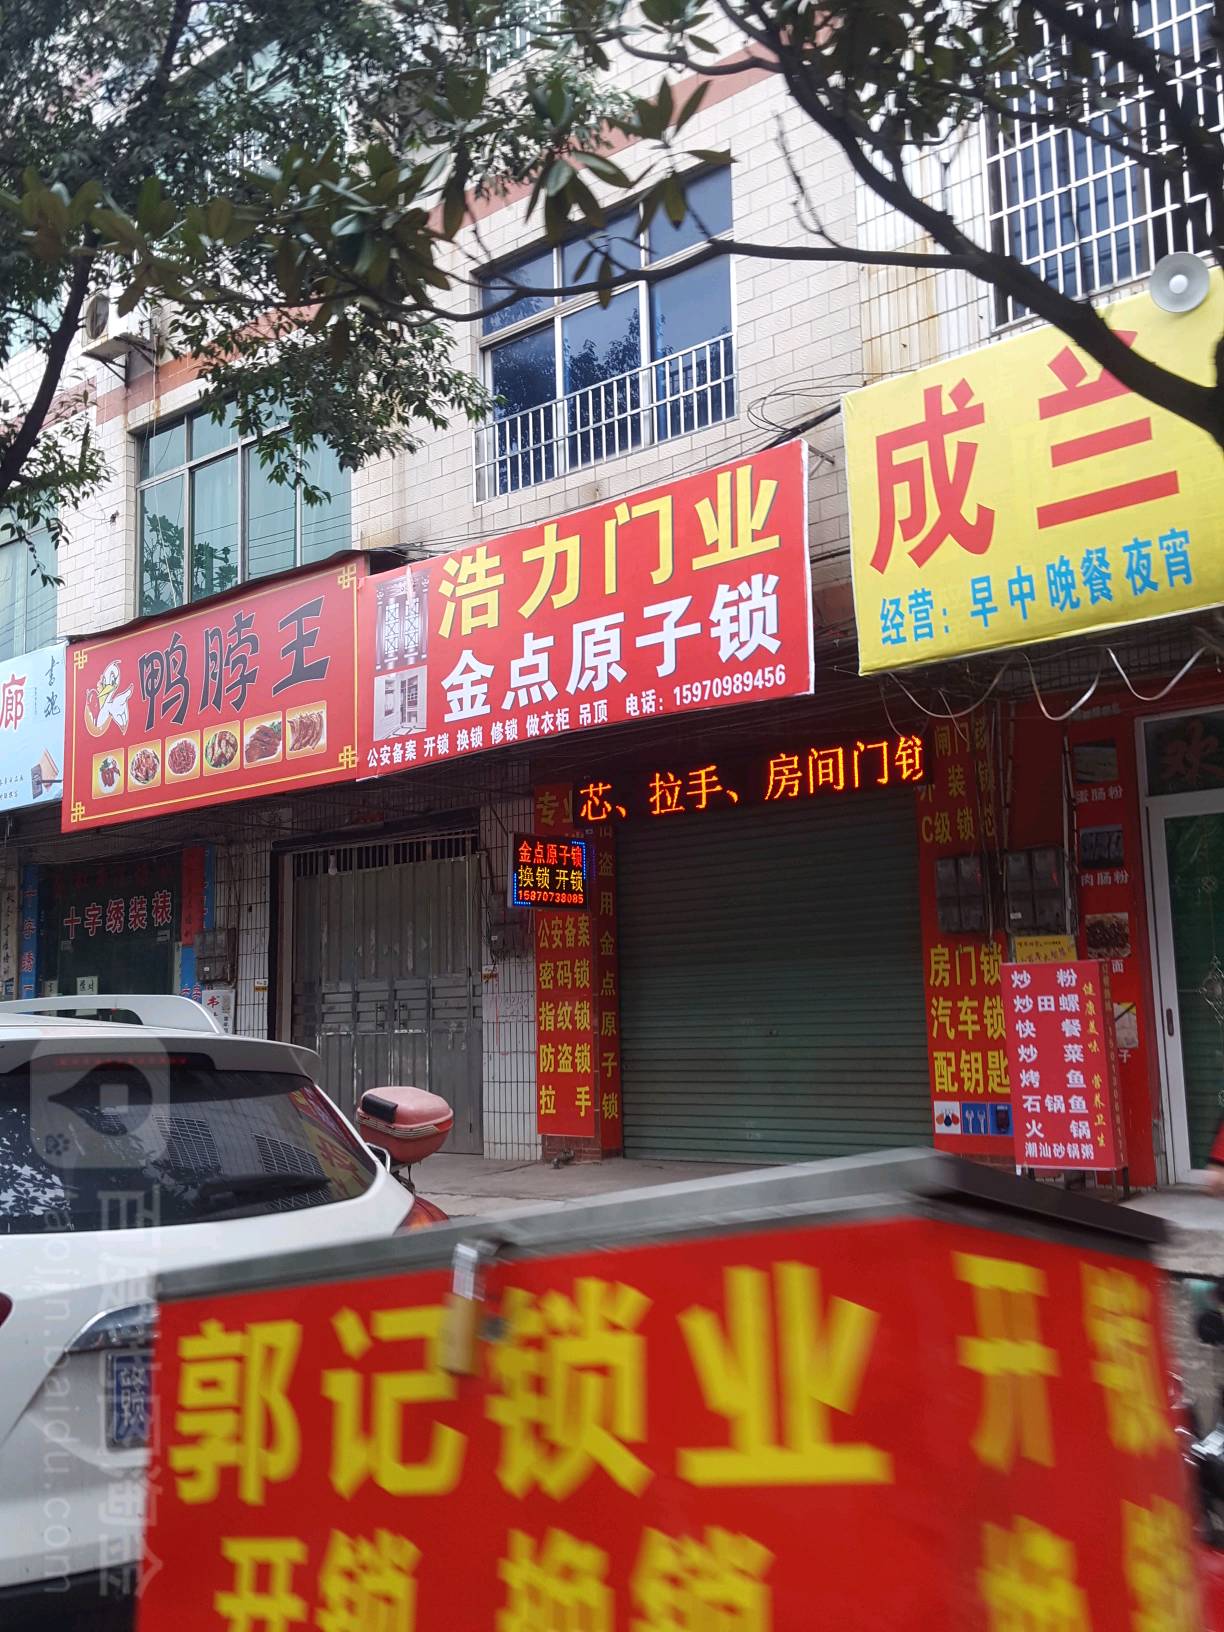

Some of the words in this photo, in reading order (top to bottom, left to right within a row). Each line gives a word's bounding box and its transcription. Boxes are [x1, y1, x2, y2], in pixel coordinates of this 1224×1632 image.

[437, 464, 781, 638] 浩力门业
[137, 595, 331, 732] 鸭脖王
[441, 573, 783, 723] 金点原子锁
[367, 741, 417, 769] 公安备案
[424, 732, 450, 757] 开锁
[456, 726, 483, 751] 换锁
[491, 719, 519, 745] 修锁
[526, 707, 570, 737] 做衣柜
[579, 698, 608, 723] 吊顶
[518, 841, 583, 867] 金点原子锁
[518, 865, 550, 891] 换锁
[555, 869, 584, 893] 开锁
[538, 915, 591, 949] 公安备案
[539, 959, 590, 990] 密码锁
[929, 943, 1002, 988] 房门锁
[539, 1000, 591, 1031] 指纹锁
[930, 995, 1006, 1041] 汽车锁
[539, 1043, 591, 1073] 防盗锁
[932, 1049, 1011, 1095] 配钥匙
[539, 1085, 592, 1118] 拉手
[1022, 1094, 1088, 1114] 石锅鱼
[1025, 1119, 1091, 1140] 火锅
[168, 1261, 893, 1505] 郭记锁业
